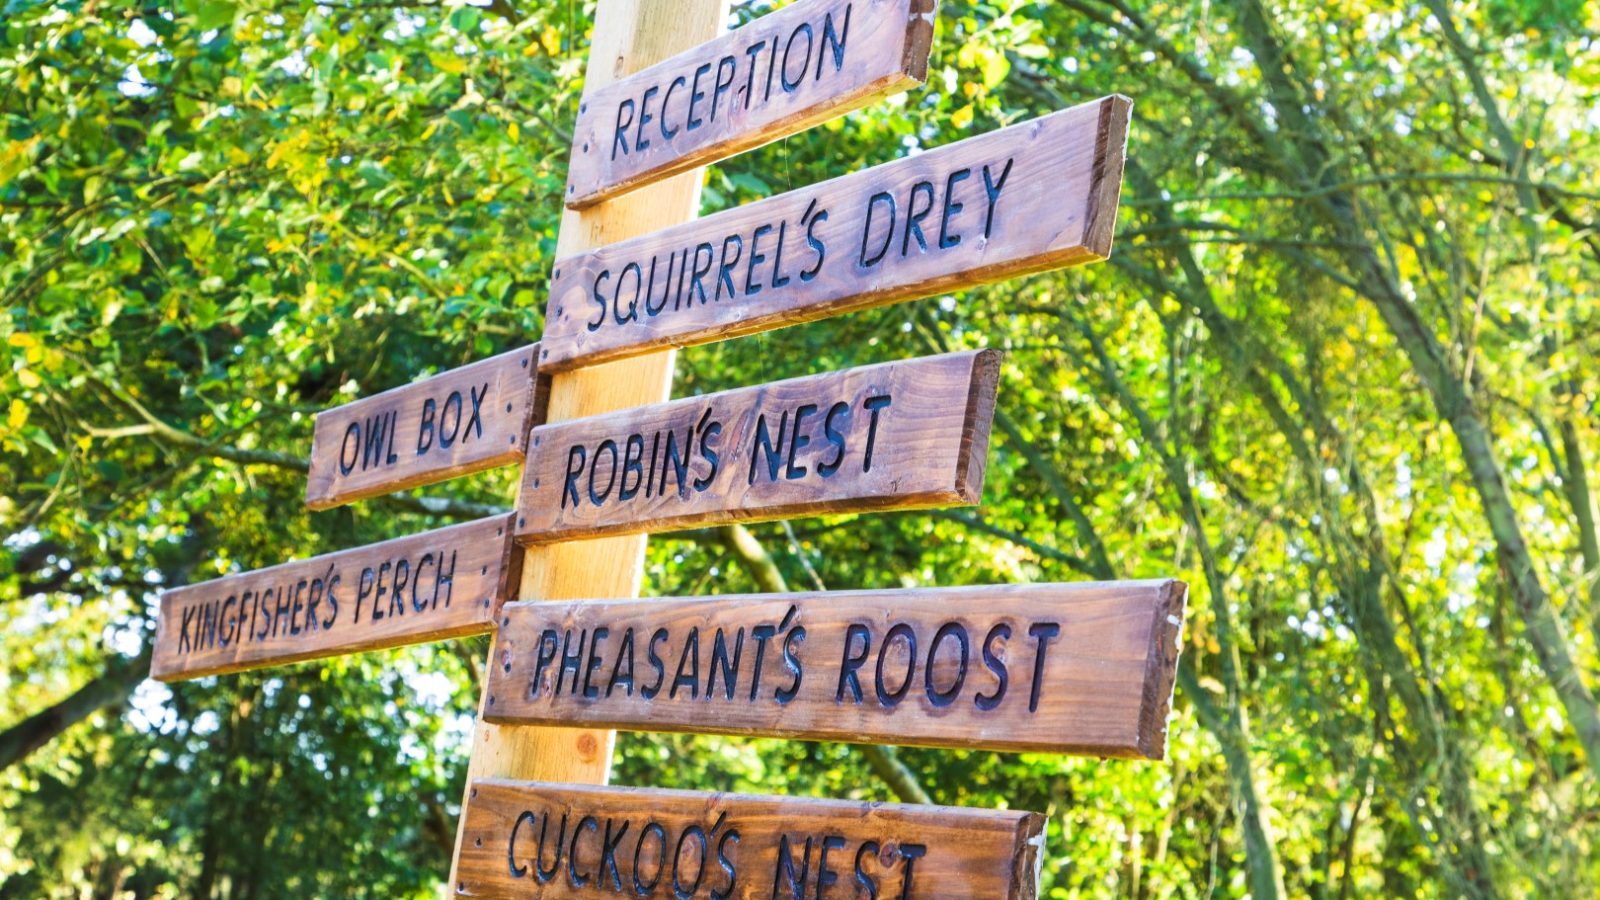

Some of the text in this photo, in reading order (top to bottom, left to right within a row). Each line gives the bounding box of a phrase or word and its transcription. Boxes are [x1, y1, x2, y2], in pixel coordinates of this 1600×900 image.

[611, 3, 852, 162] RECEPTION
[586, 158, 1014, 332] SQUIRREL'S DREY
[339, 383, 488, 477] OWL BOX
[561, 395, 892, 510] ROBIN'S NEST
[178, 550, 457, 655] KINGFISHER'S PERCH
[531, 605, 1061, 713] PHEASANT'S ROOST
[508, 811, 927, 900] CUCKOO'S NEST
